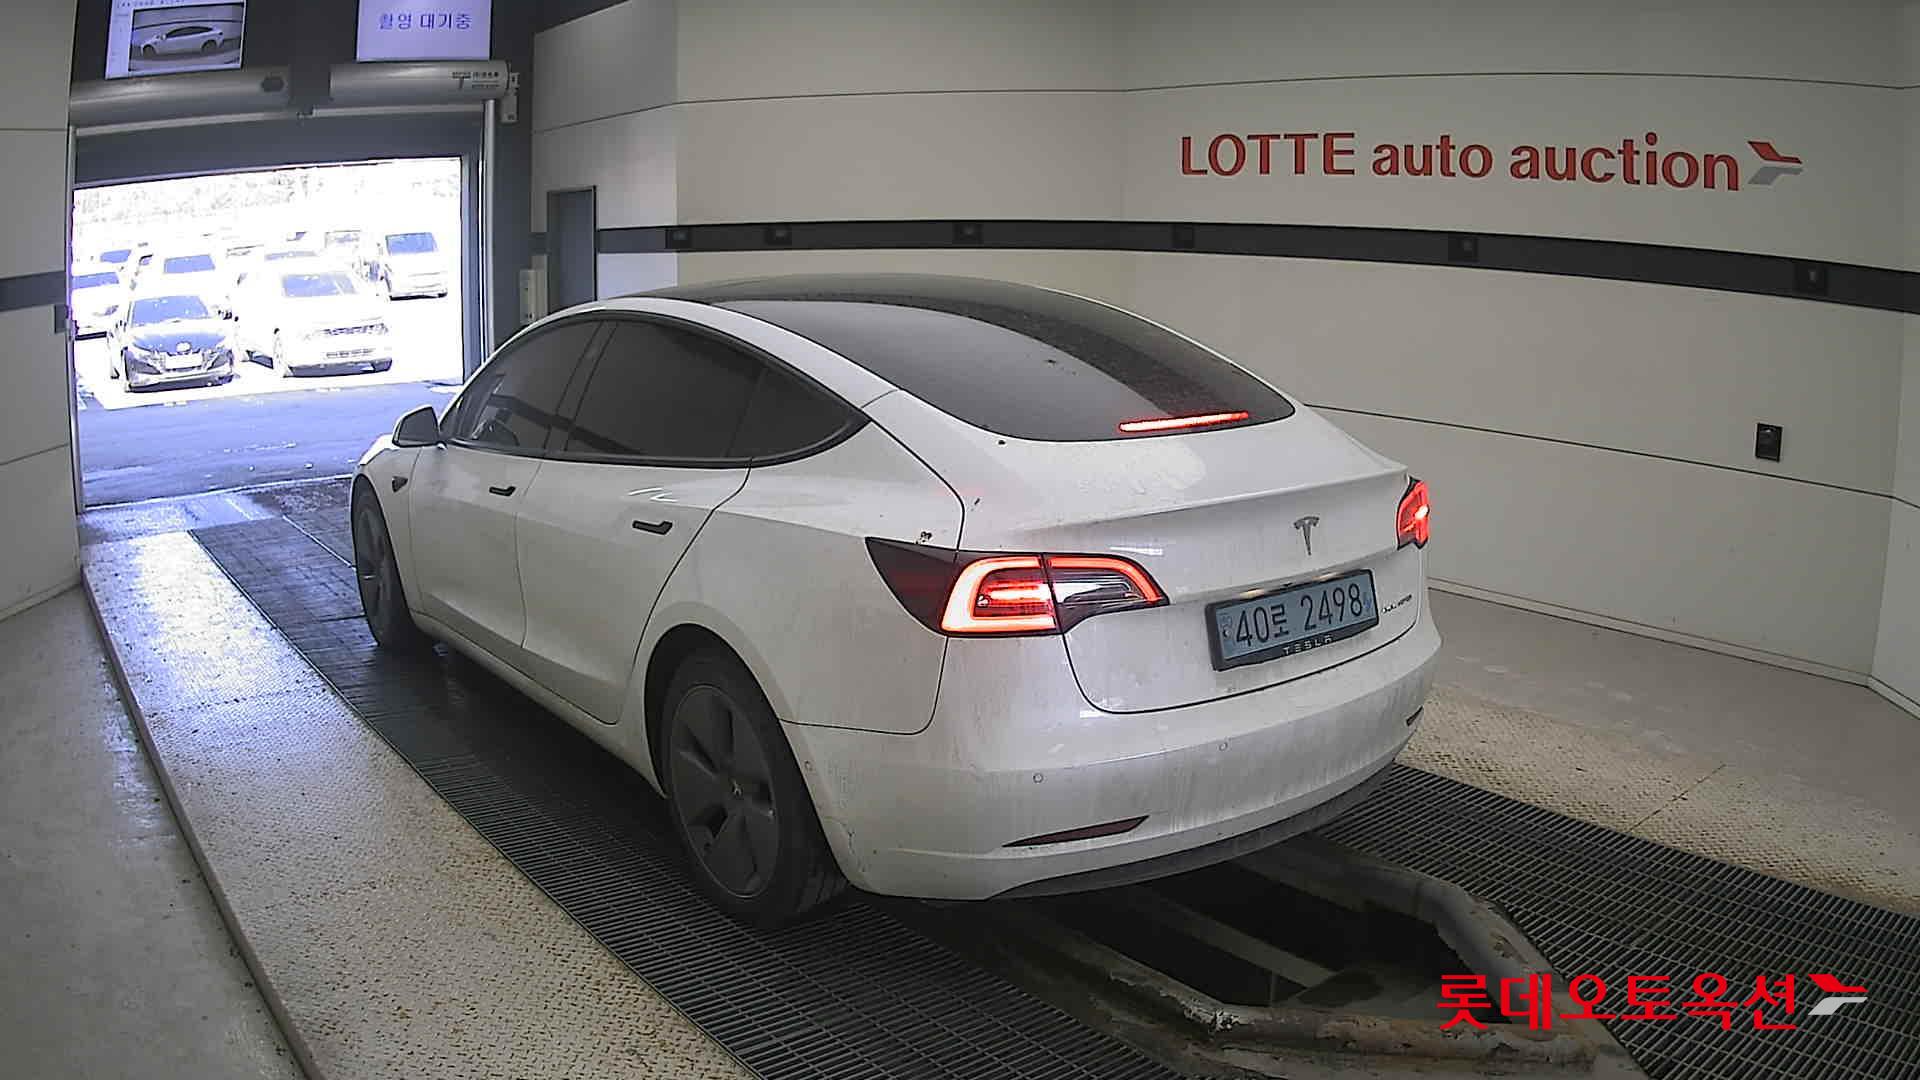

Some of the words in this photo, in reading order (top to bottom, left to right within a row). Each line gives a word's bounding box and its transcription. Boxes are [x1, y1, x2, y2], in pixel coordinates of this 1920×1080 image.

[420, 13, 472, 29] 대기중
[1181, 132, 1356, 176] LOTTE
[1371, 134, 1493, 178] auto
[1509, 132, 1740, 191] auction
[1236, 602, 1289, 647] 40로
[1300, 583, 1363, 632] 2498
[1283, 635, 1333, 655] TESLA
